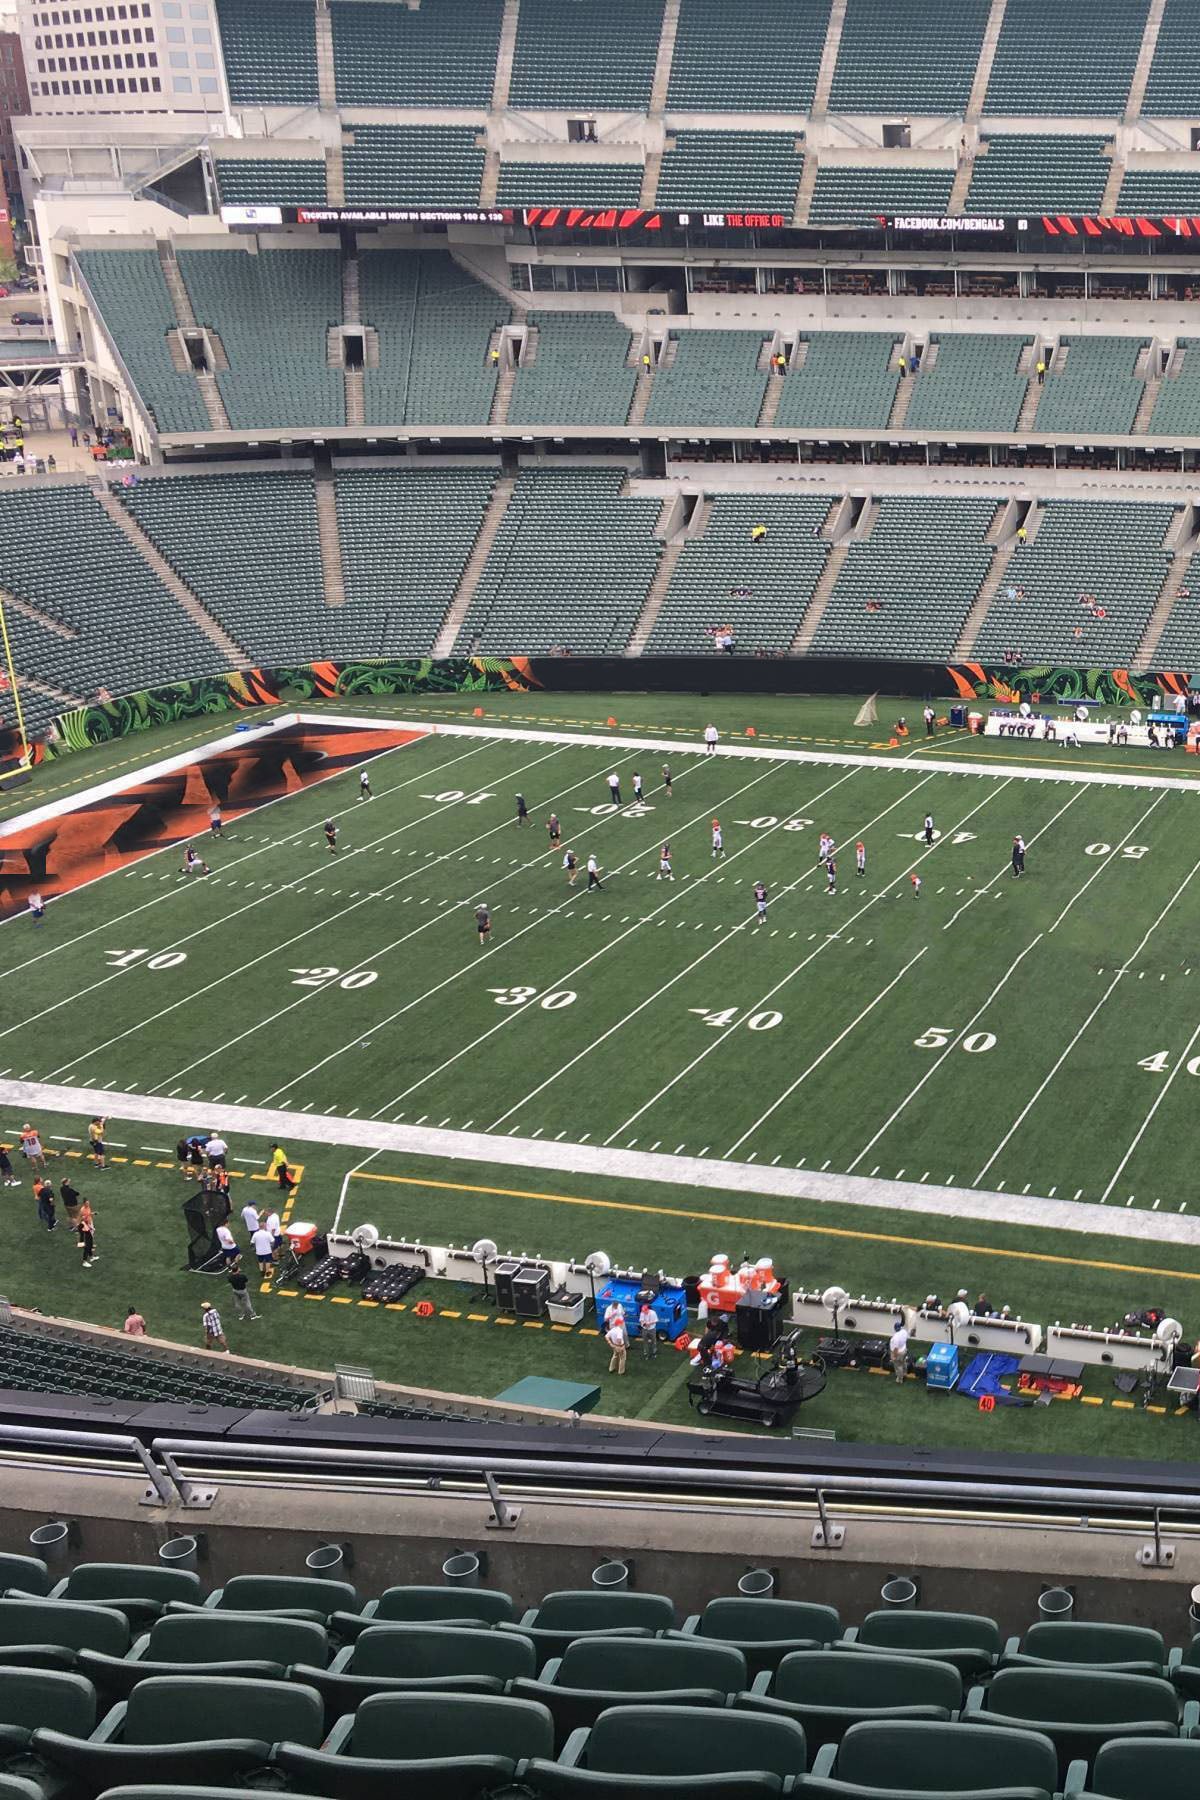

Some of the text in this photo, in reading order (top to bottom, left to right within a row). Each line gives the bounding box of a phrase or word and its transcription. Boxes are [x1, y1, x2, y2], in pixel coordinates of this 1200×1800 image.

[301, 211, 338, 220] TICKETS
[340, 211, 386, 220] AVAILABLE
[388, 212, 408, 220] NOW
[409, 212, 419, 220] IN
[420, 212, 461, 220] SECTIONS
[703, 214, 725, 226] LIKE
[726, 214, 743, 227] THE
[894, 217, 1004, 230] FACEBOOK.COM/BENGALS
[434, 790, 497, 804] 10
[590, 801, 656, 818] 20
[750, 816, 814, 831] 30
[914, 829, 978, 844] 40
[1084, 843, 1149, 859] 50
[105, 948, 187, 970] 10
[290, 967, 378, 989] 20
[494, 986, 577, 1010] 30
[701, 1007, 783, 1030] 40
[913, 1027, 997, 1053] 50
[706, 1291, 720, 1305] G
[980, 1398, 992, 1409] 40
